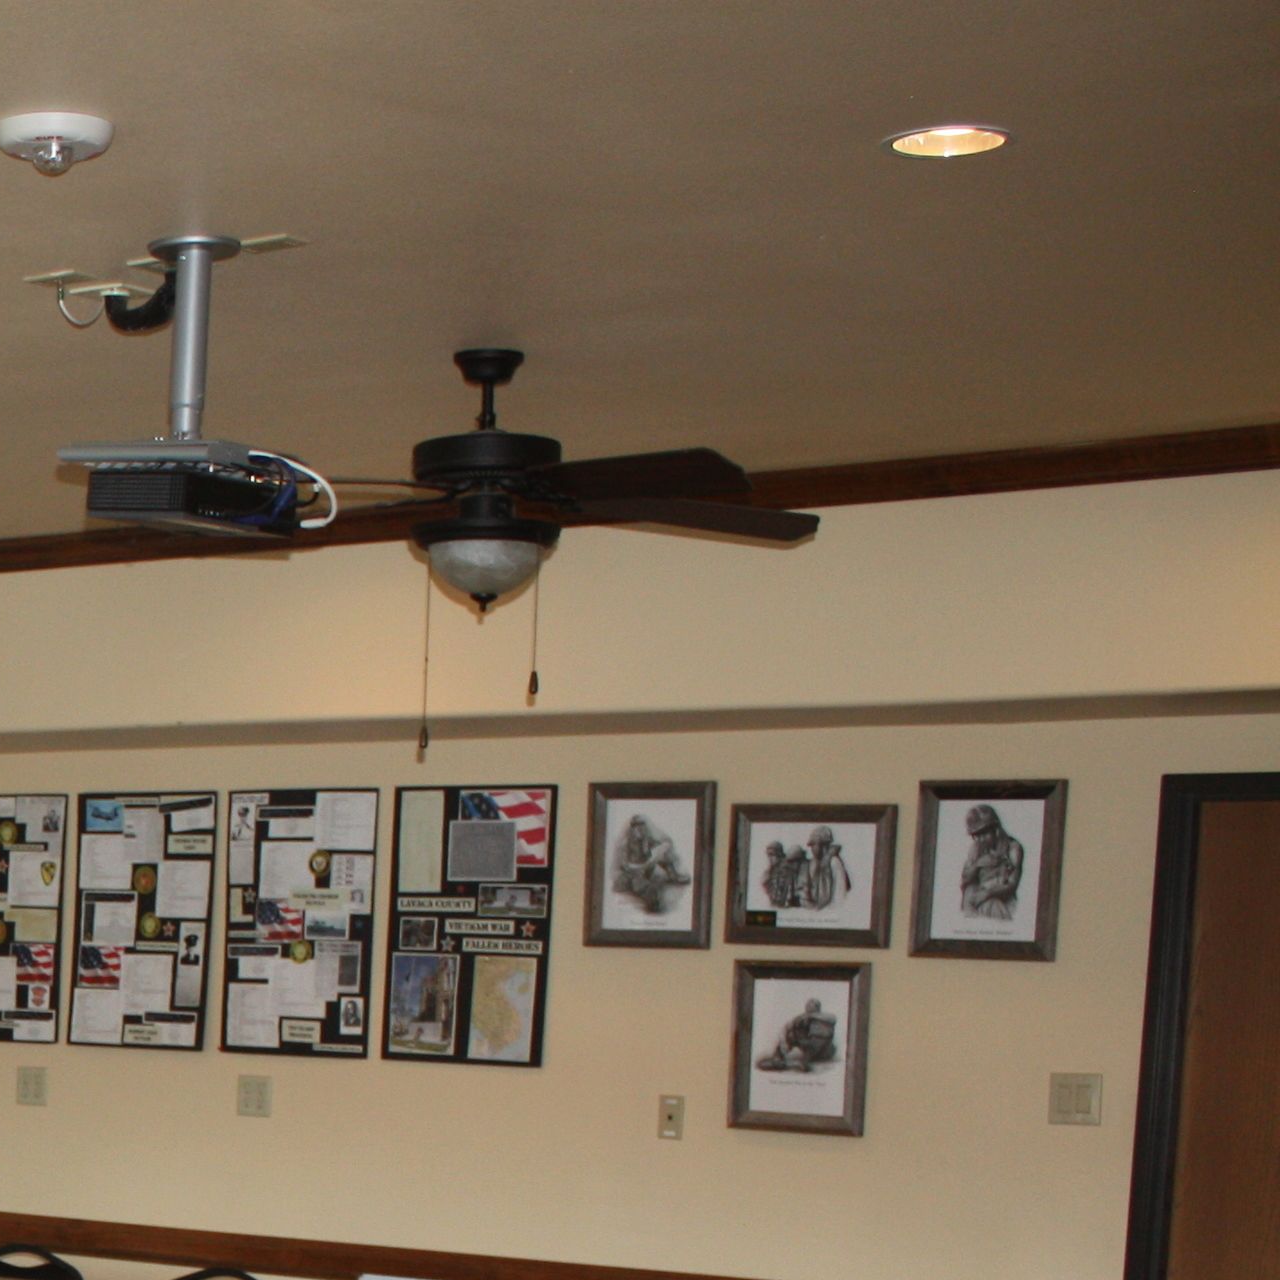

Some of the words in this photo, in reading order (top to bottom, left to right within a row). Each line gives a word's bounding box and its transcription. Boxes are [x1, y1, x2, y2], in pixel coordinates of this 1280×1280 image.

[448, 921, 489, 932] VIETNAM
[490, 922, 510, 933] WAR
[465, 940, 500, 950] FALLEN
[502, 942, 540, 951] HEROES
